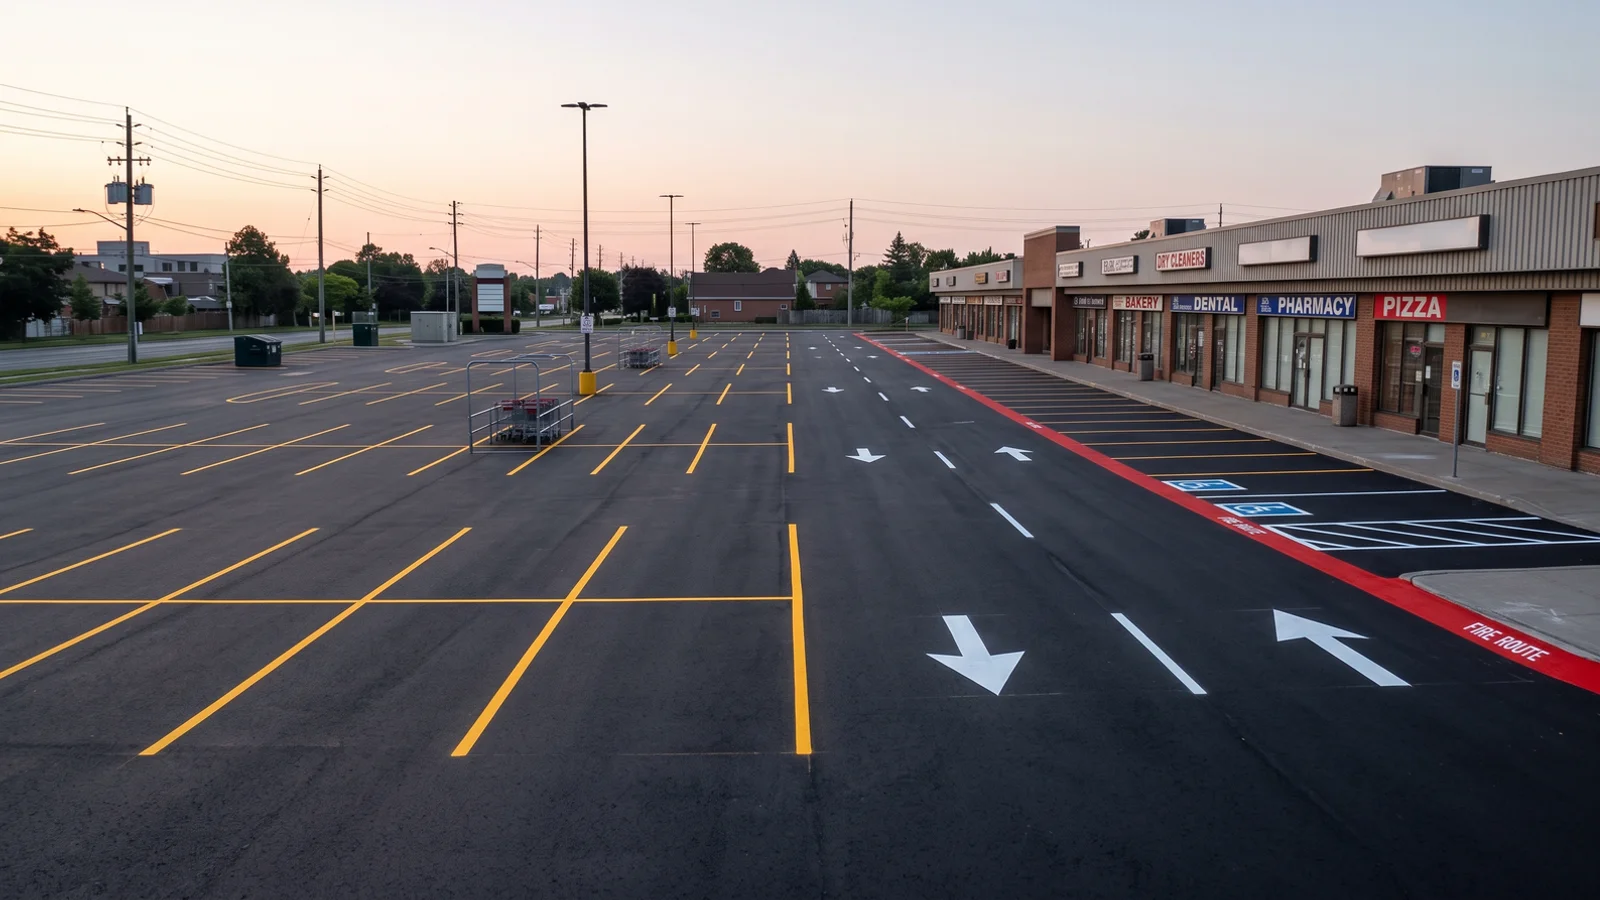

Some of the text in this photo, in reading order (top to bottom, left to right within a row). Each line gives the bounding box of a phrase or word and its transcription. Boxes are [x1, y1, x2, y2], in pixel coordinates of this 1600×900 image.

[1157, 250, 1205, 269] DRY CLEANERS
[1125, 296, 1159, 309] BAKERY
[1194, 296, 1238, 312] DENTAL
[1278, 296, 1353, 315] PHARMACY
[1383, 296, 1441, 317] PIZZA
[1463, 622, 1550, 661] FIRE ROUTE
